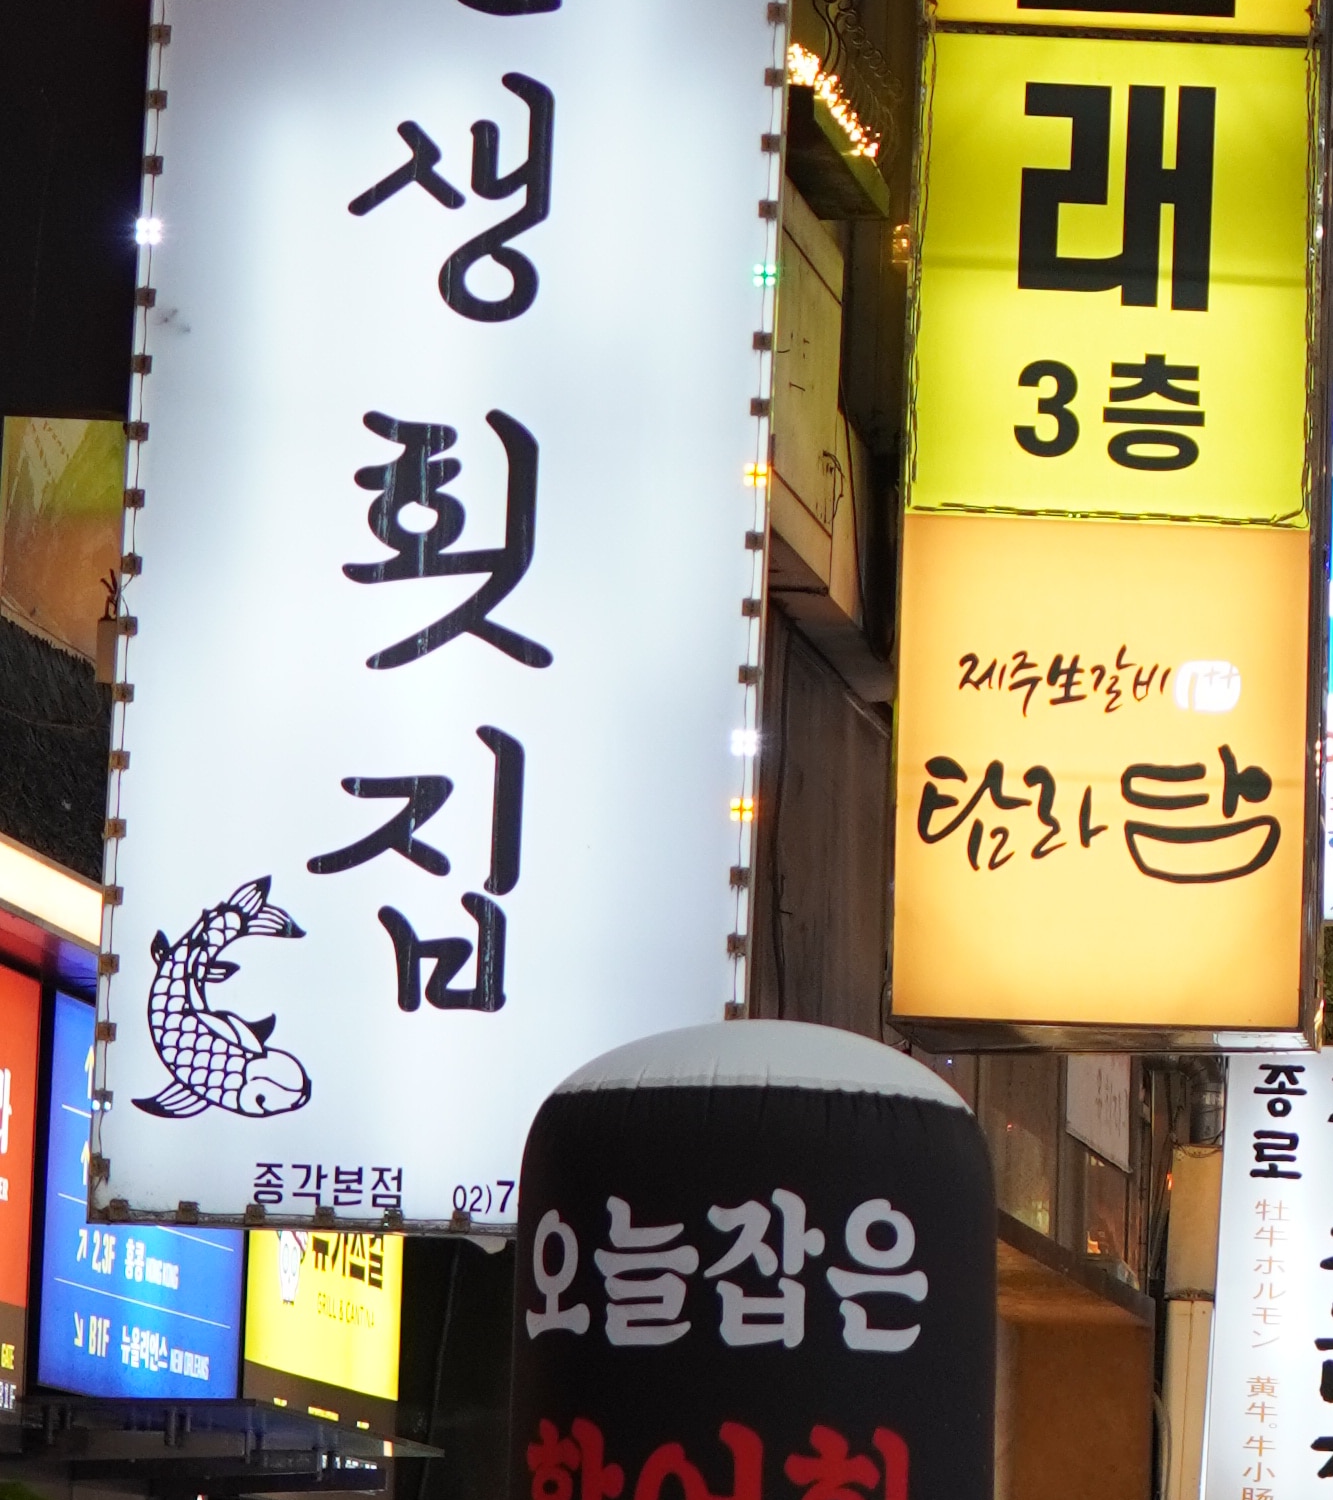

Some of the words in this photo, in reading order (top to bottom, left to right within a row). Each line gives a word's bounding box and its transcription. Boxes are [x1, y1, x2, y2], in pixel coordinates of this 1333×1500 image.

[1013, 355, 1206, 471] 3층
[1250, 1064, 1308, 1180] 종로
[252, 1162, 404, 1210] 종각본점
[125, 1238, 146, 1282] 홍콩
[525, 1188, 930, 1354] 오늘잡은
